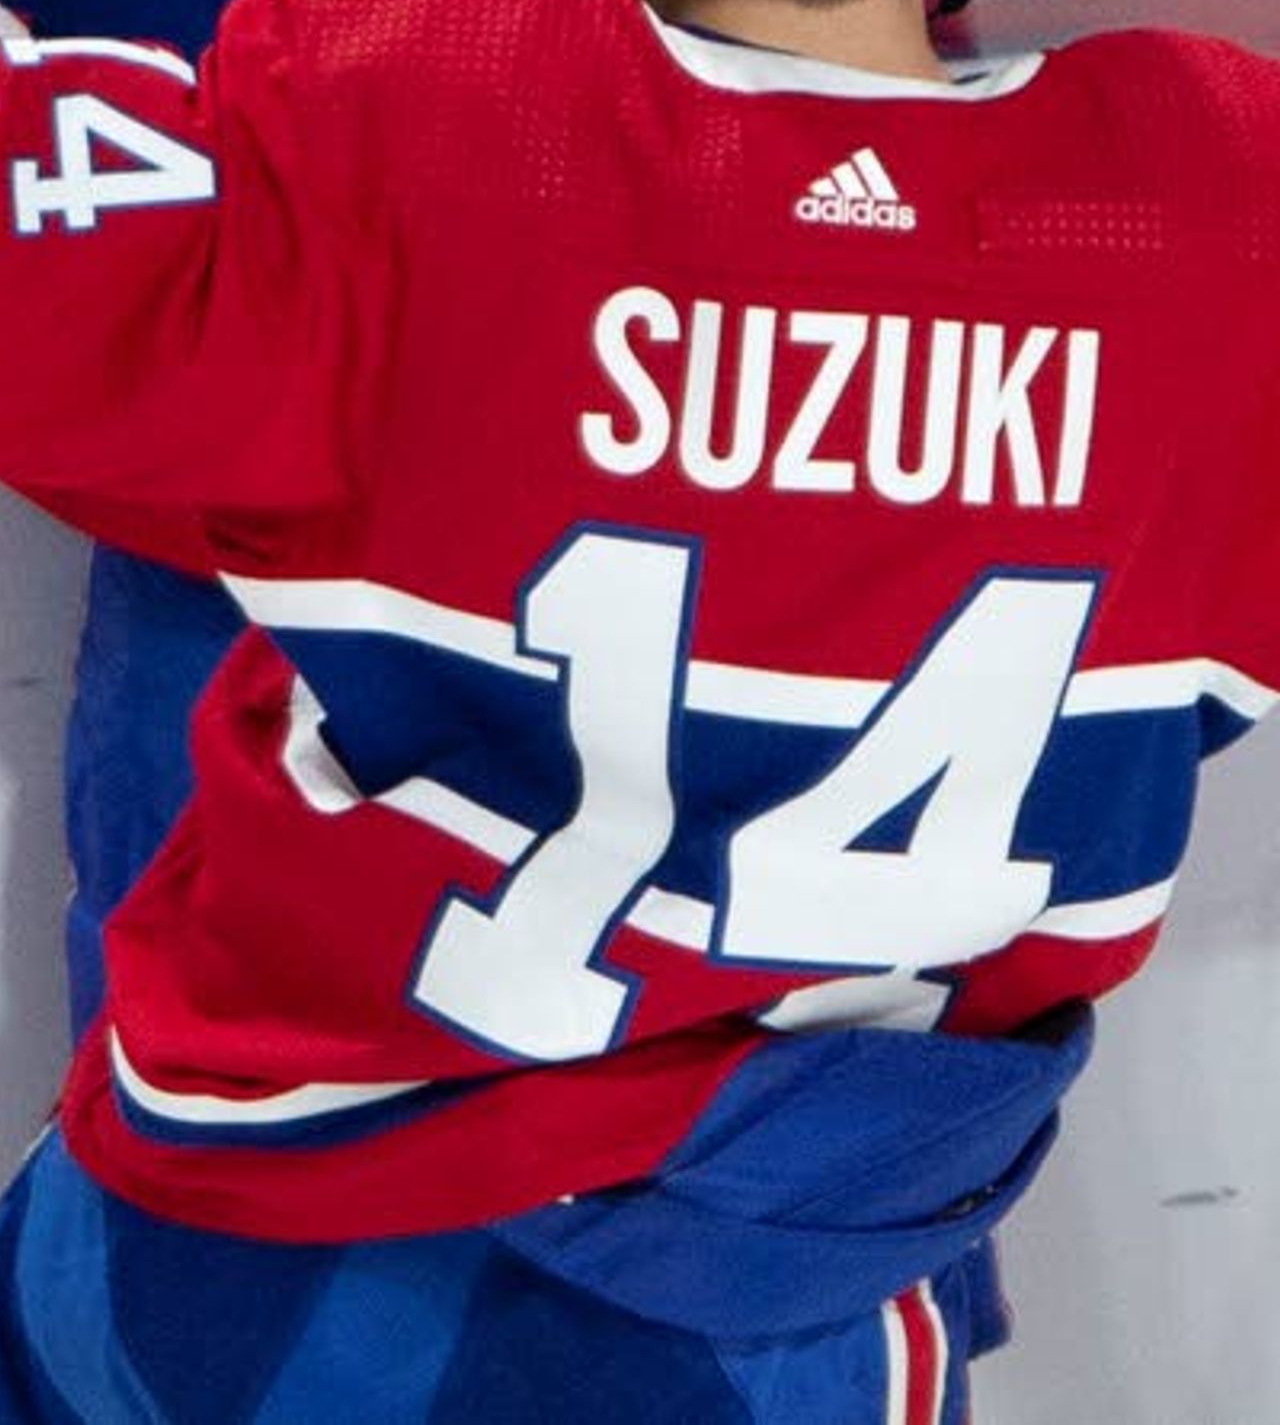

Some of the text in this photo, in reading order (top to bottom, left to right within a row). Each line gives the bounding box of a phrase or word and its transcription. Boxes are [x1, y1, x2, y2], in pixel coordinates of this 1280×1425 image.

[793, 192, 918, 233] adidas
[580, 285, 1100, 508] SUZUKI
[405, 519, 1106, 1064] 14
